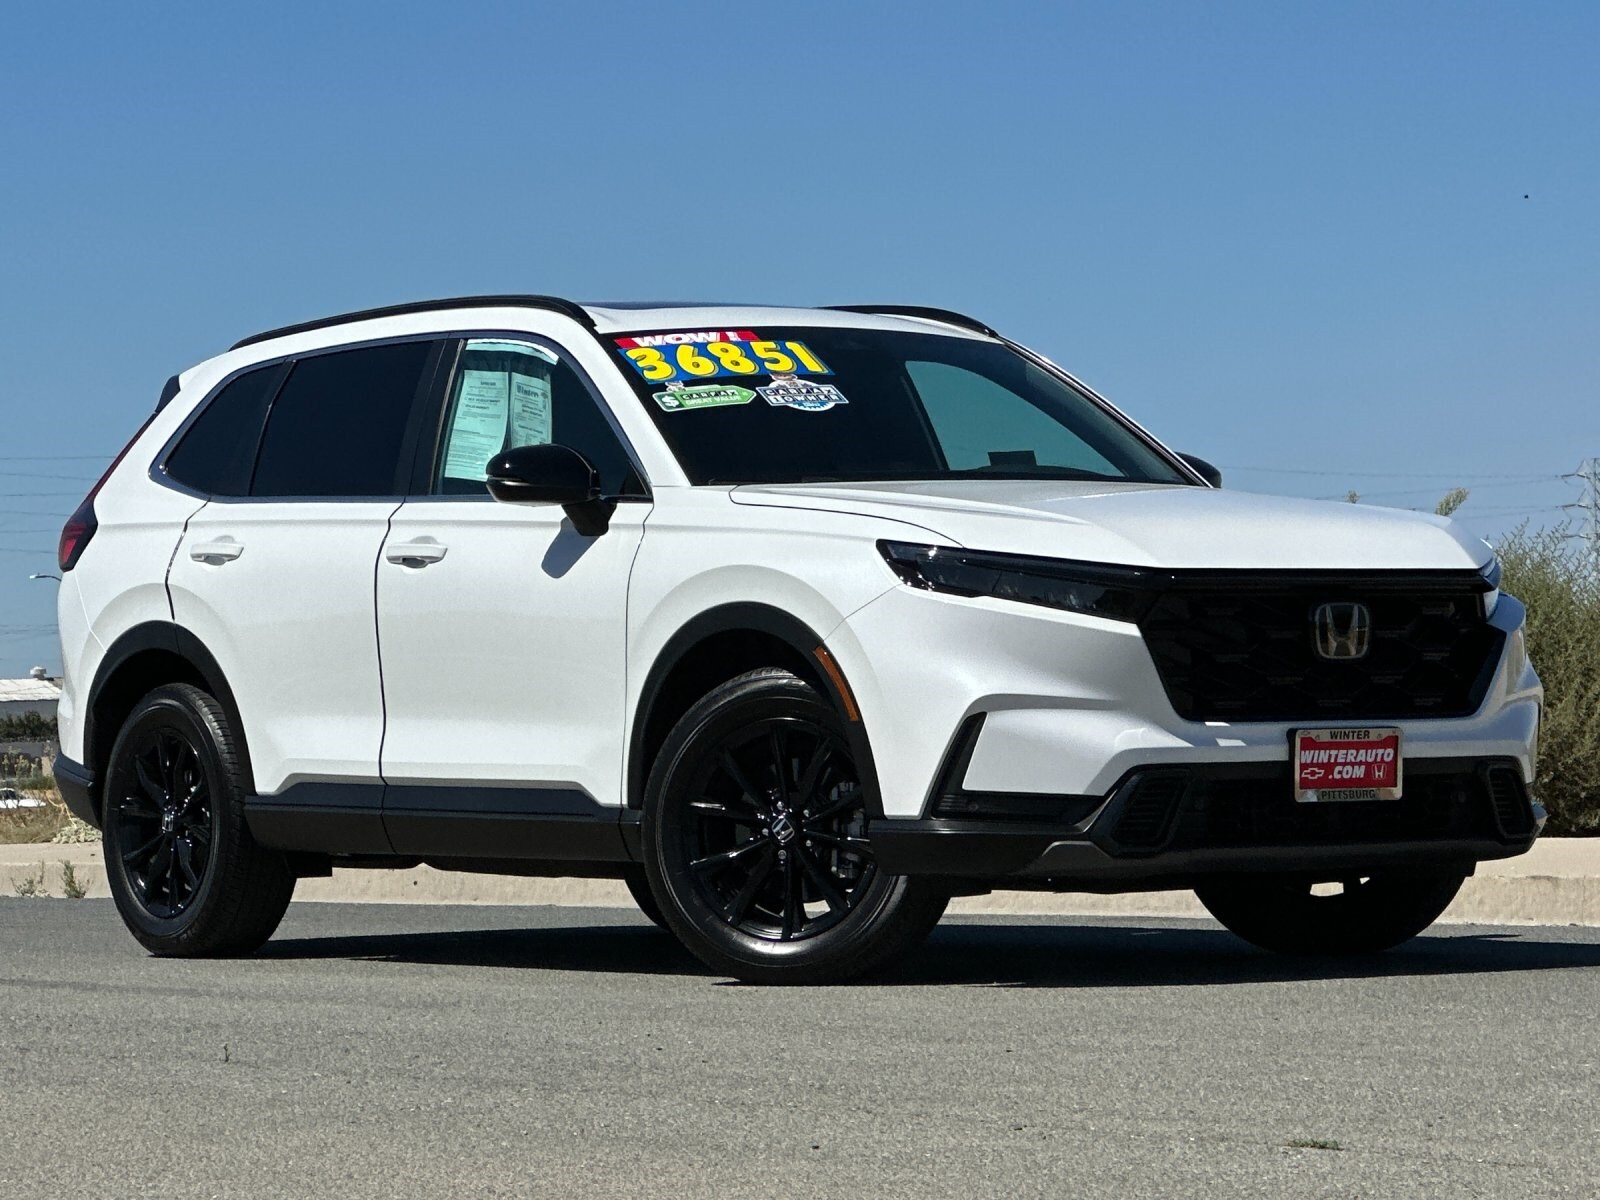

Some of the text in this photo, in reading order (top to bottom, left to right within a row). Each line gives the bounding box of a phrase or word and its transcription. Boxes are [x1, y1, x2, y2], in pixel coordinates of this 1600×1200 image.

[625, 341, 829, 381] 36851
[680, 389, 739, 401] CARFAX
[764, 387, 836, 396] CARFAX
[1330, 730, 1371, 740] WINTER
[1300, 748, 1395, 764] WINTERAUTO
[1328, 764, 1366, 780] .COM
[1321, 789, 1376, 800] PITTSBURG
